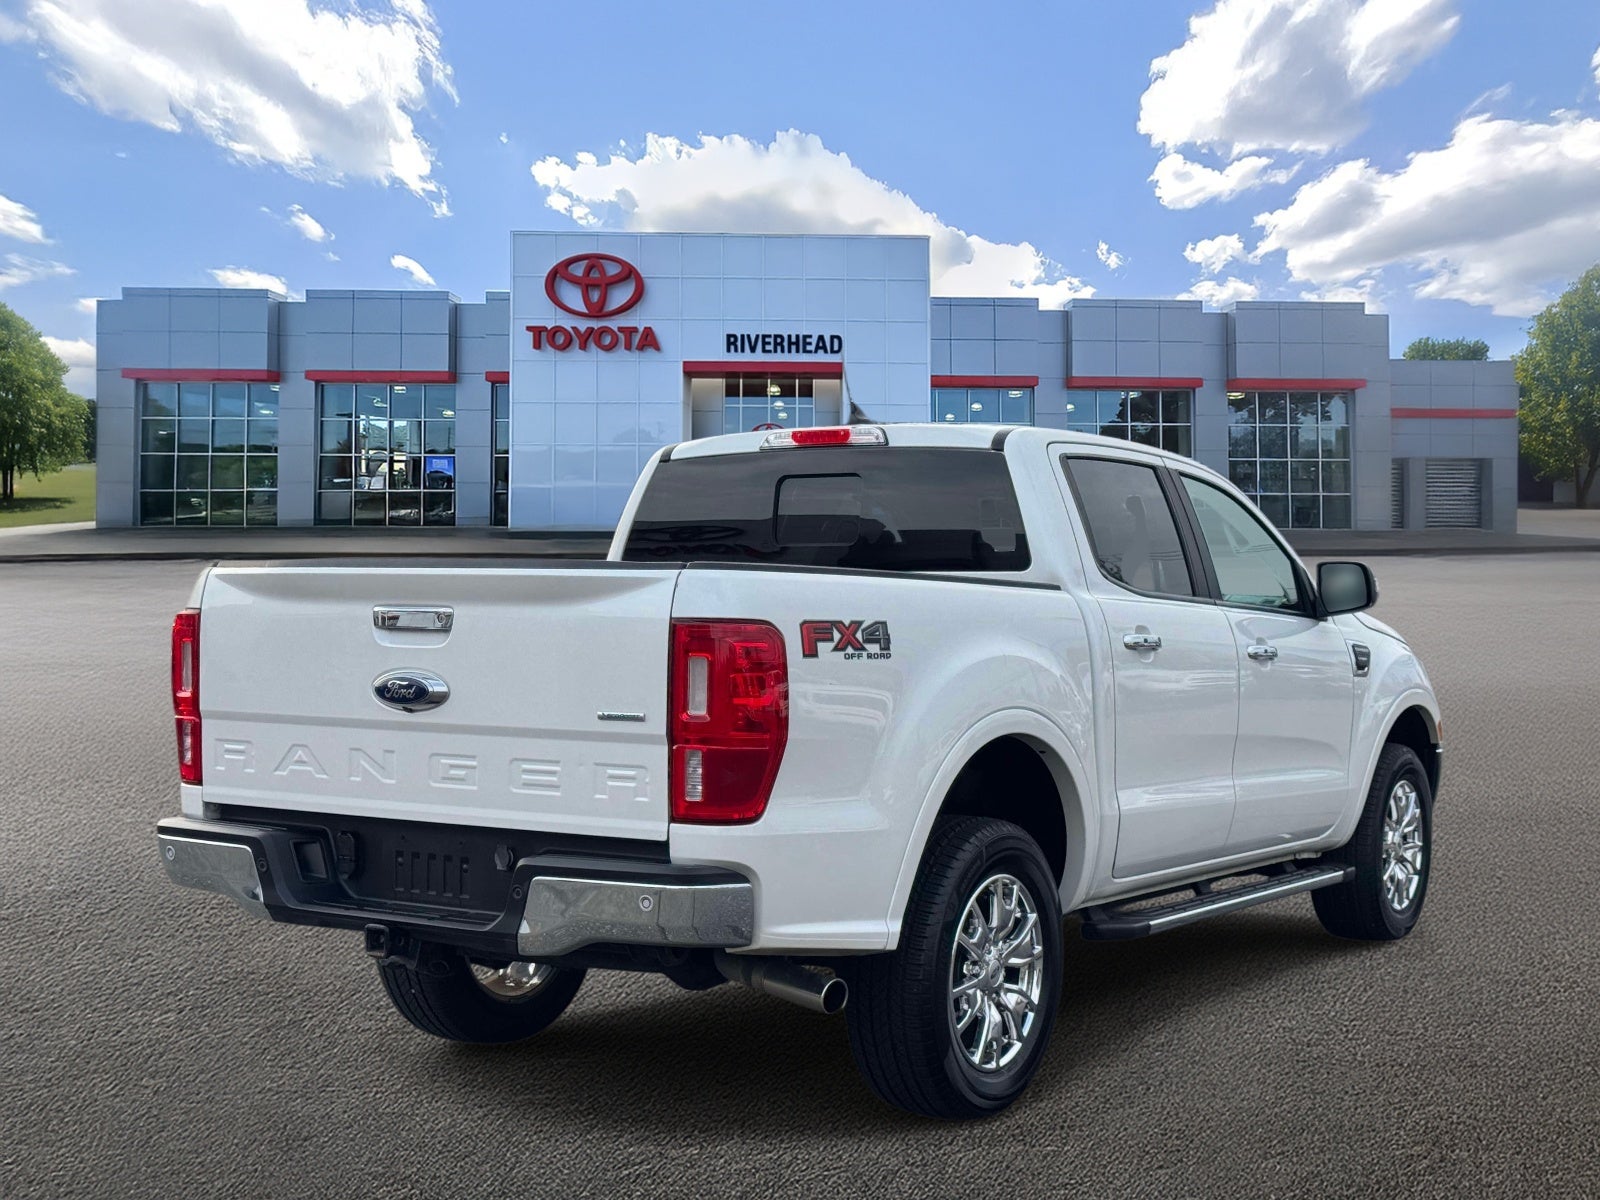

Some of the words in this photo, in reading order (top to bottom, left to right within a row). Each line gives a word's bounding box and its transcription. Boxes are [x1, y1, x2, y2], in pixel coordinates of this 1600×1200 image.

[526, 325, 661, 351] TOYOTA
[726, 333, 843, 355] RIVERHEAD
[799, 619, 891, 659] FX4
[844, 652, 864, 660] OFF
[866, 652, 892, 660] ROAD
[384, 680, 417, 698] Ford
[214, 738, 650, 801] RANGER
